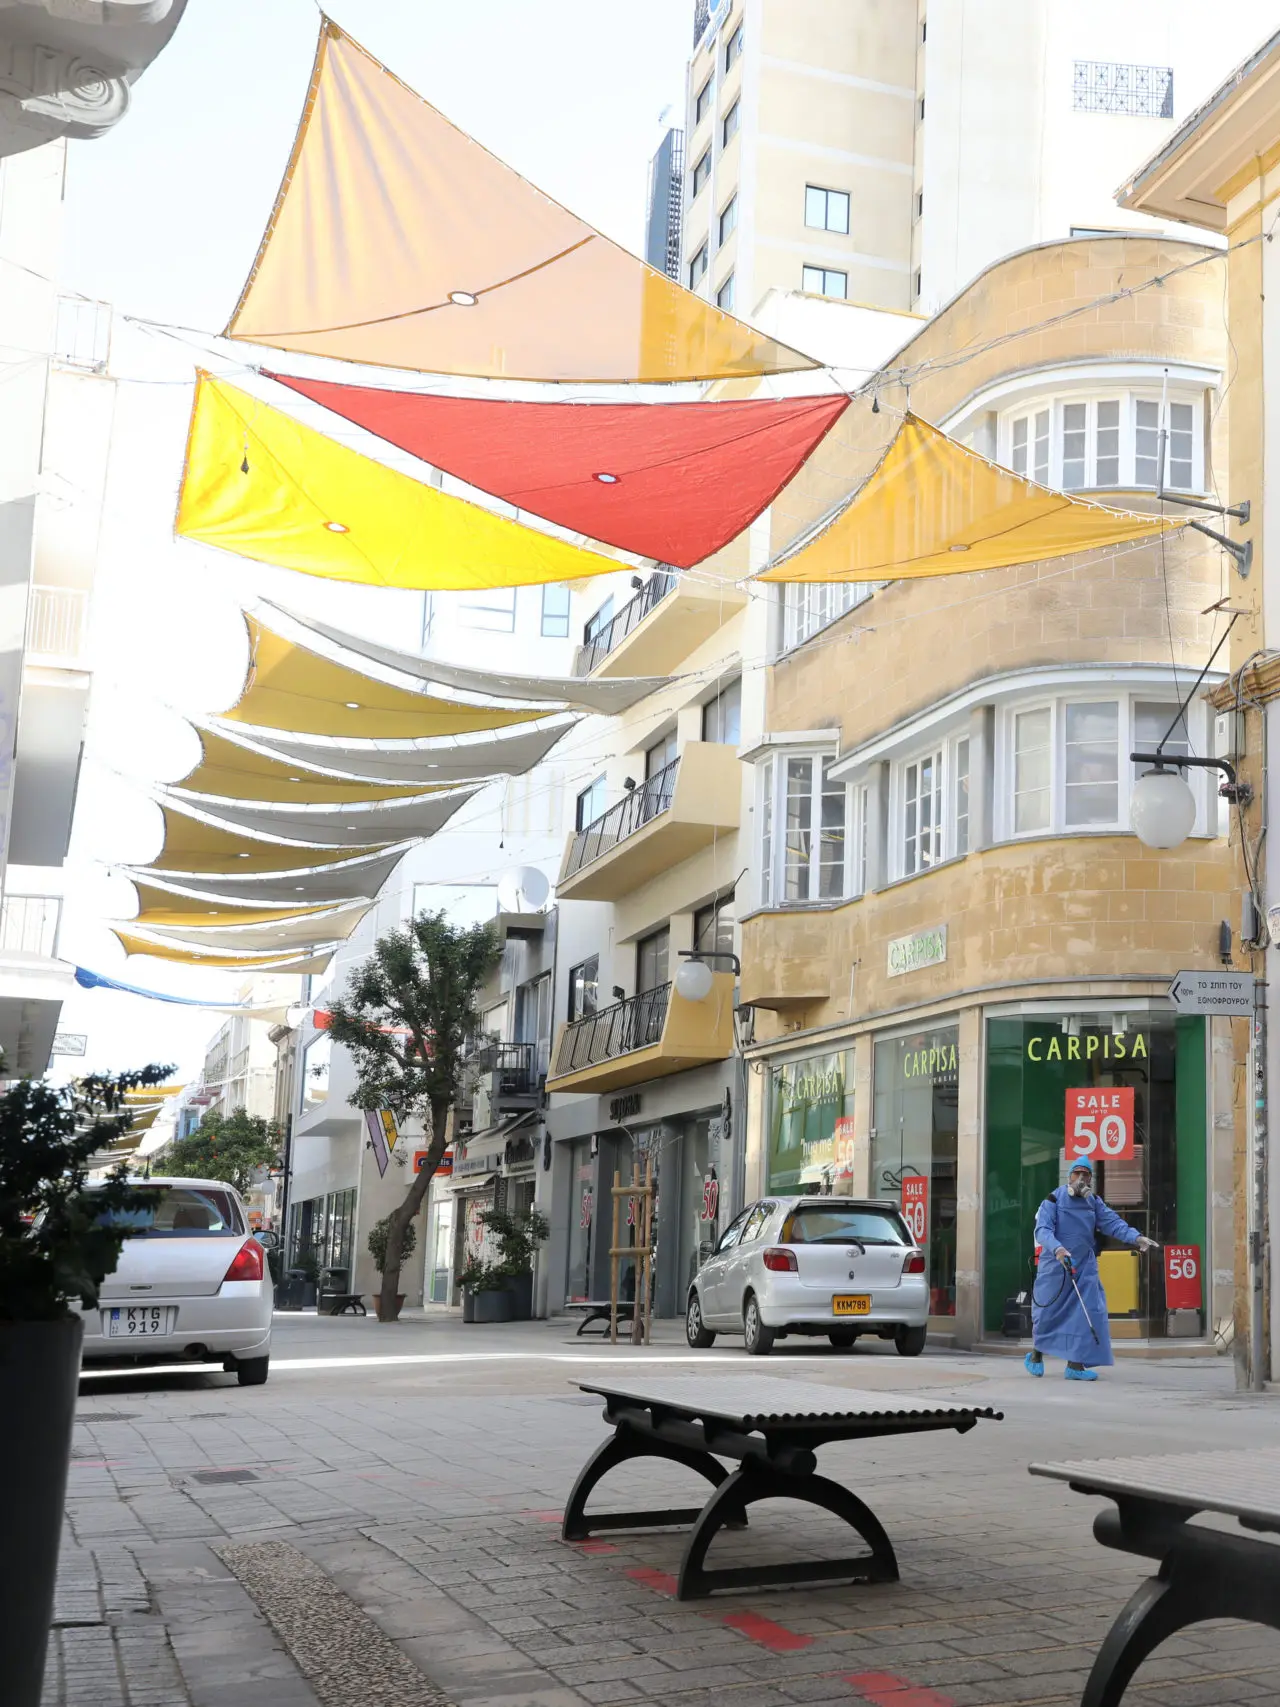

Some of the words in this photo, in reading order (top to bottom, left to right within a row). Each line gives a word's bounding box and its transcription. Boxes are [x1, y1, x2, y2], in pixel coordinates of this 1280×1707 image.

[890, 931, 944, 971] CARPISA
[1027, 1033, 1148, 1061] CARPISA
[904, 1043, 957, 1079] CARPISA
[796, 1071, 839, 1100] CARPISA
[1077, 1094, 1121, 1108] SALE
[1072, 1114, 1127, 1156] 50
[701, 1179, 719, 1221] 50
[906, 1183, 923, 1195] SALE
[1170, 1248, 1193, 1256] SALE
[1169, 1258, 1197, 1279] 50
[127, 1306, 161, 1320] KTG
[127, 1320, 160, 1334] 919
